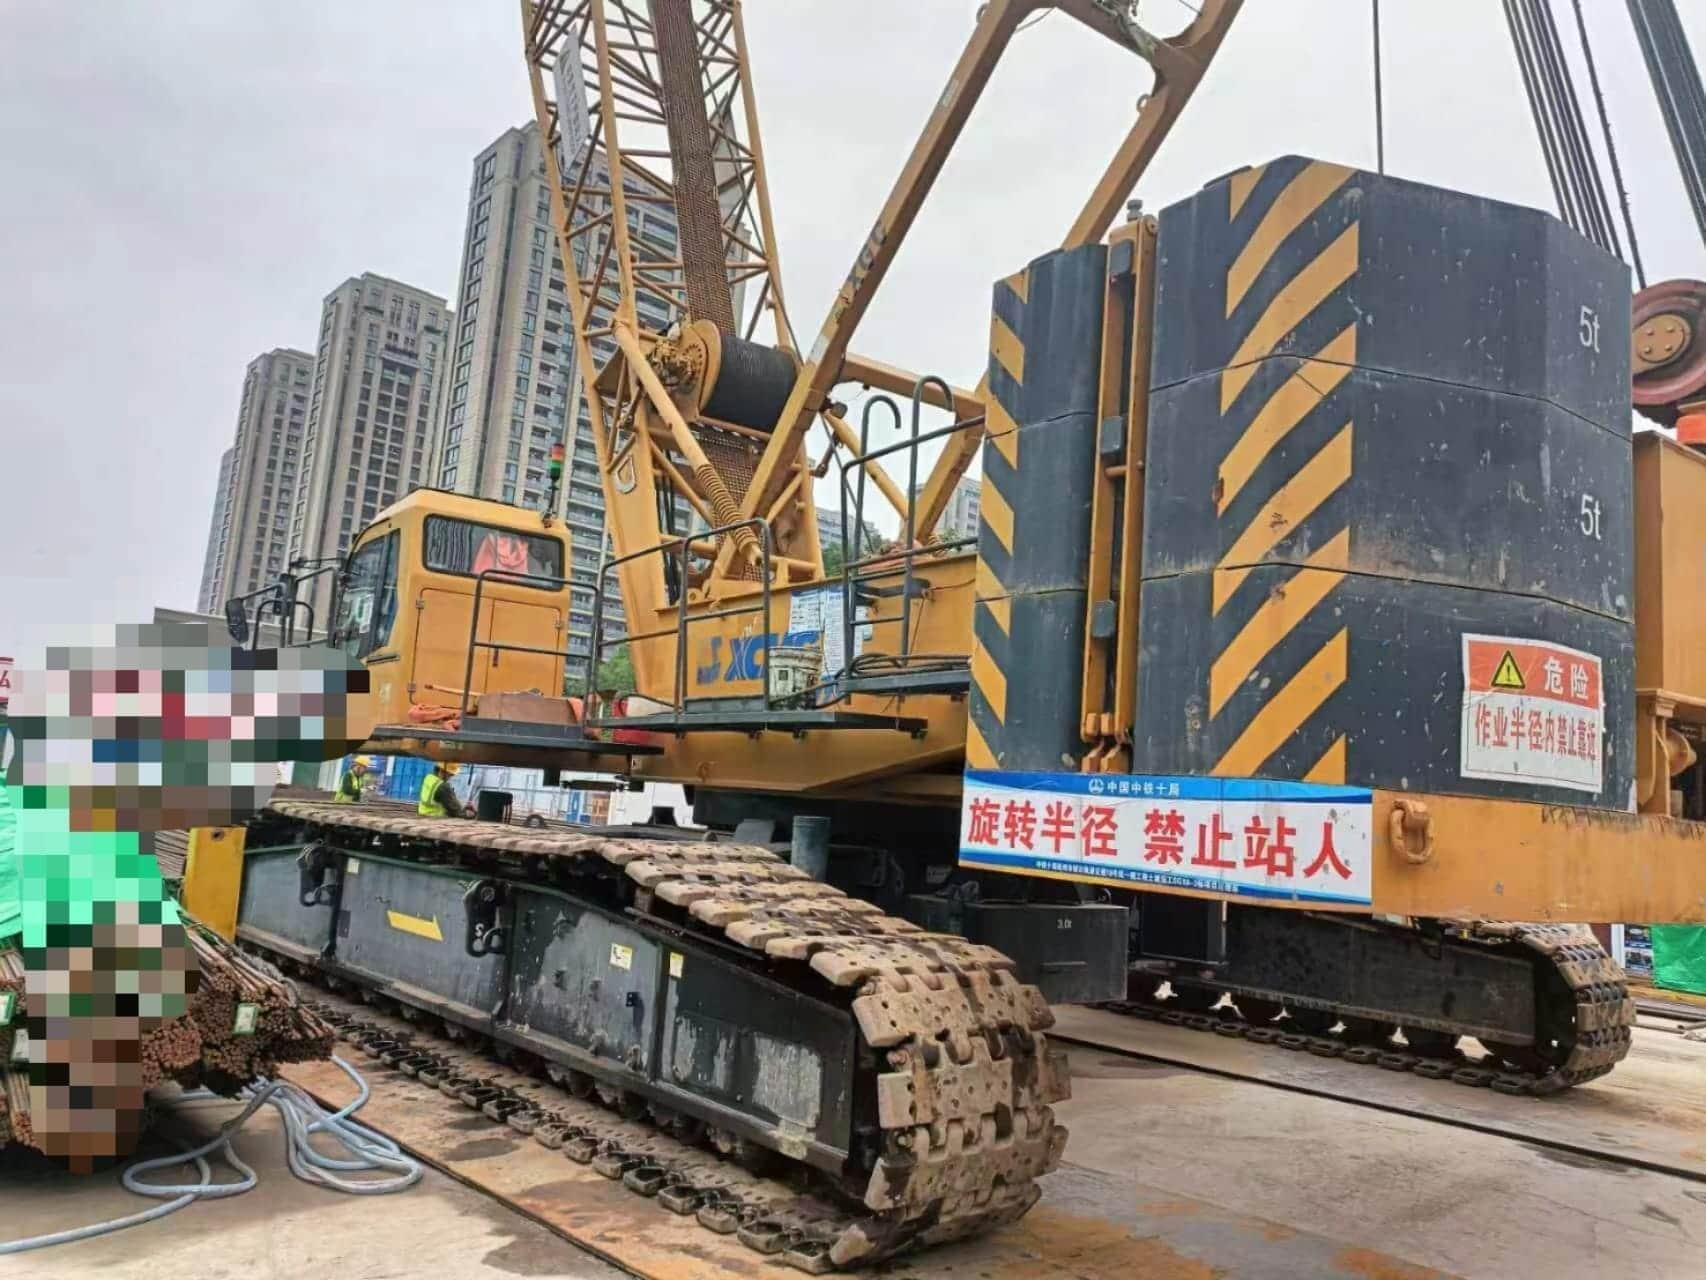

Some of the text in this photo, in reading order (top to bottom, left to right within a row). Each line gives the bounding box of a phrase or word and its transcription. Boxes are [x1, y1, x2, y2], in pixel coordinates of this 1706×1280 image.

[1579, 305, 1601, 353] 5t
[1580, 494, 1602, 541] 5t
[1544, 656, 1589, 700] 危险
[1475, 703, 1596, 761] 作业半径内禁止靠近
[1107, 781, 1180, 797] 中国中铁十局
[967, 797, 1119, 857] 旋转半径
[1143, 808, 1353, 881] 禁止站人
